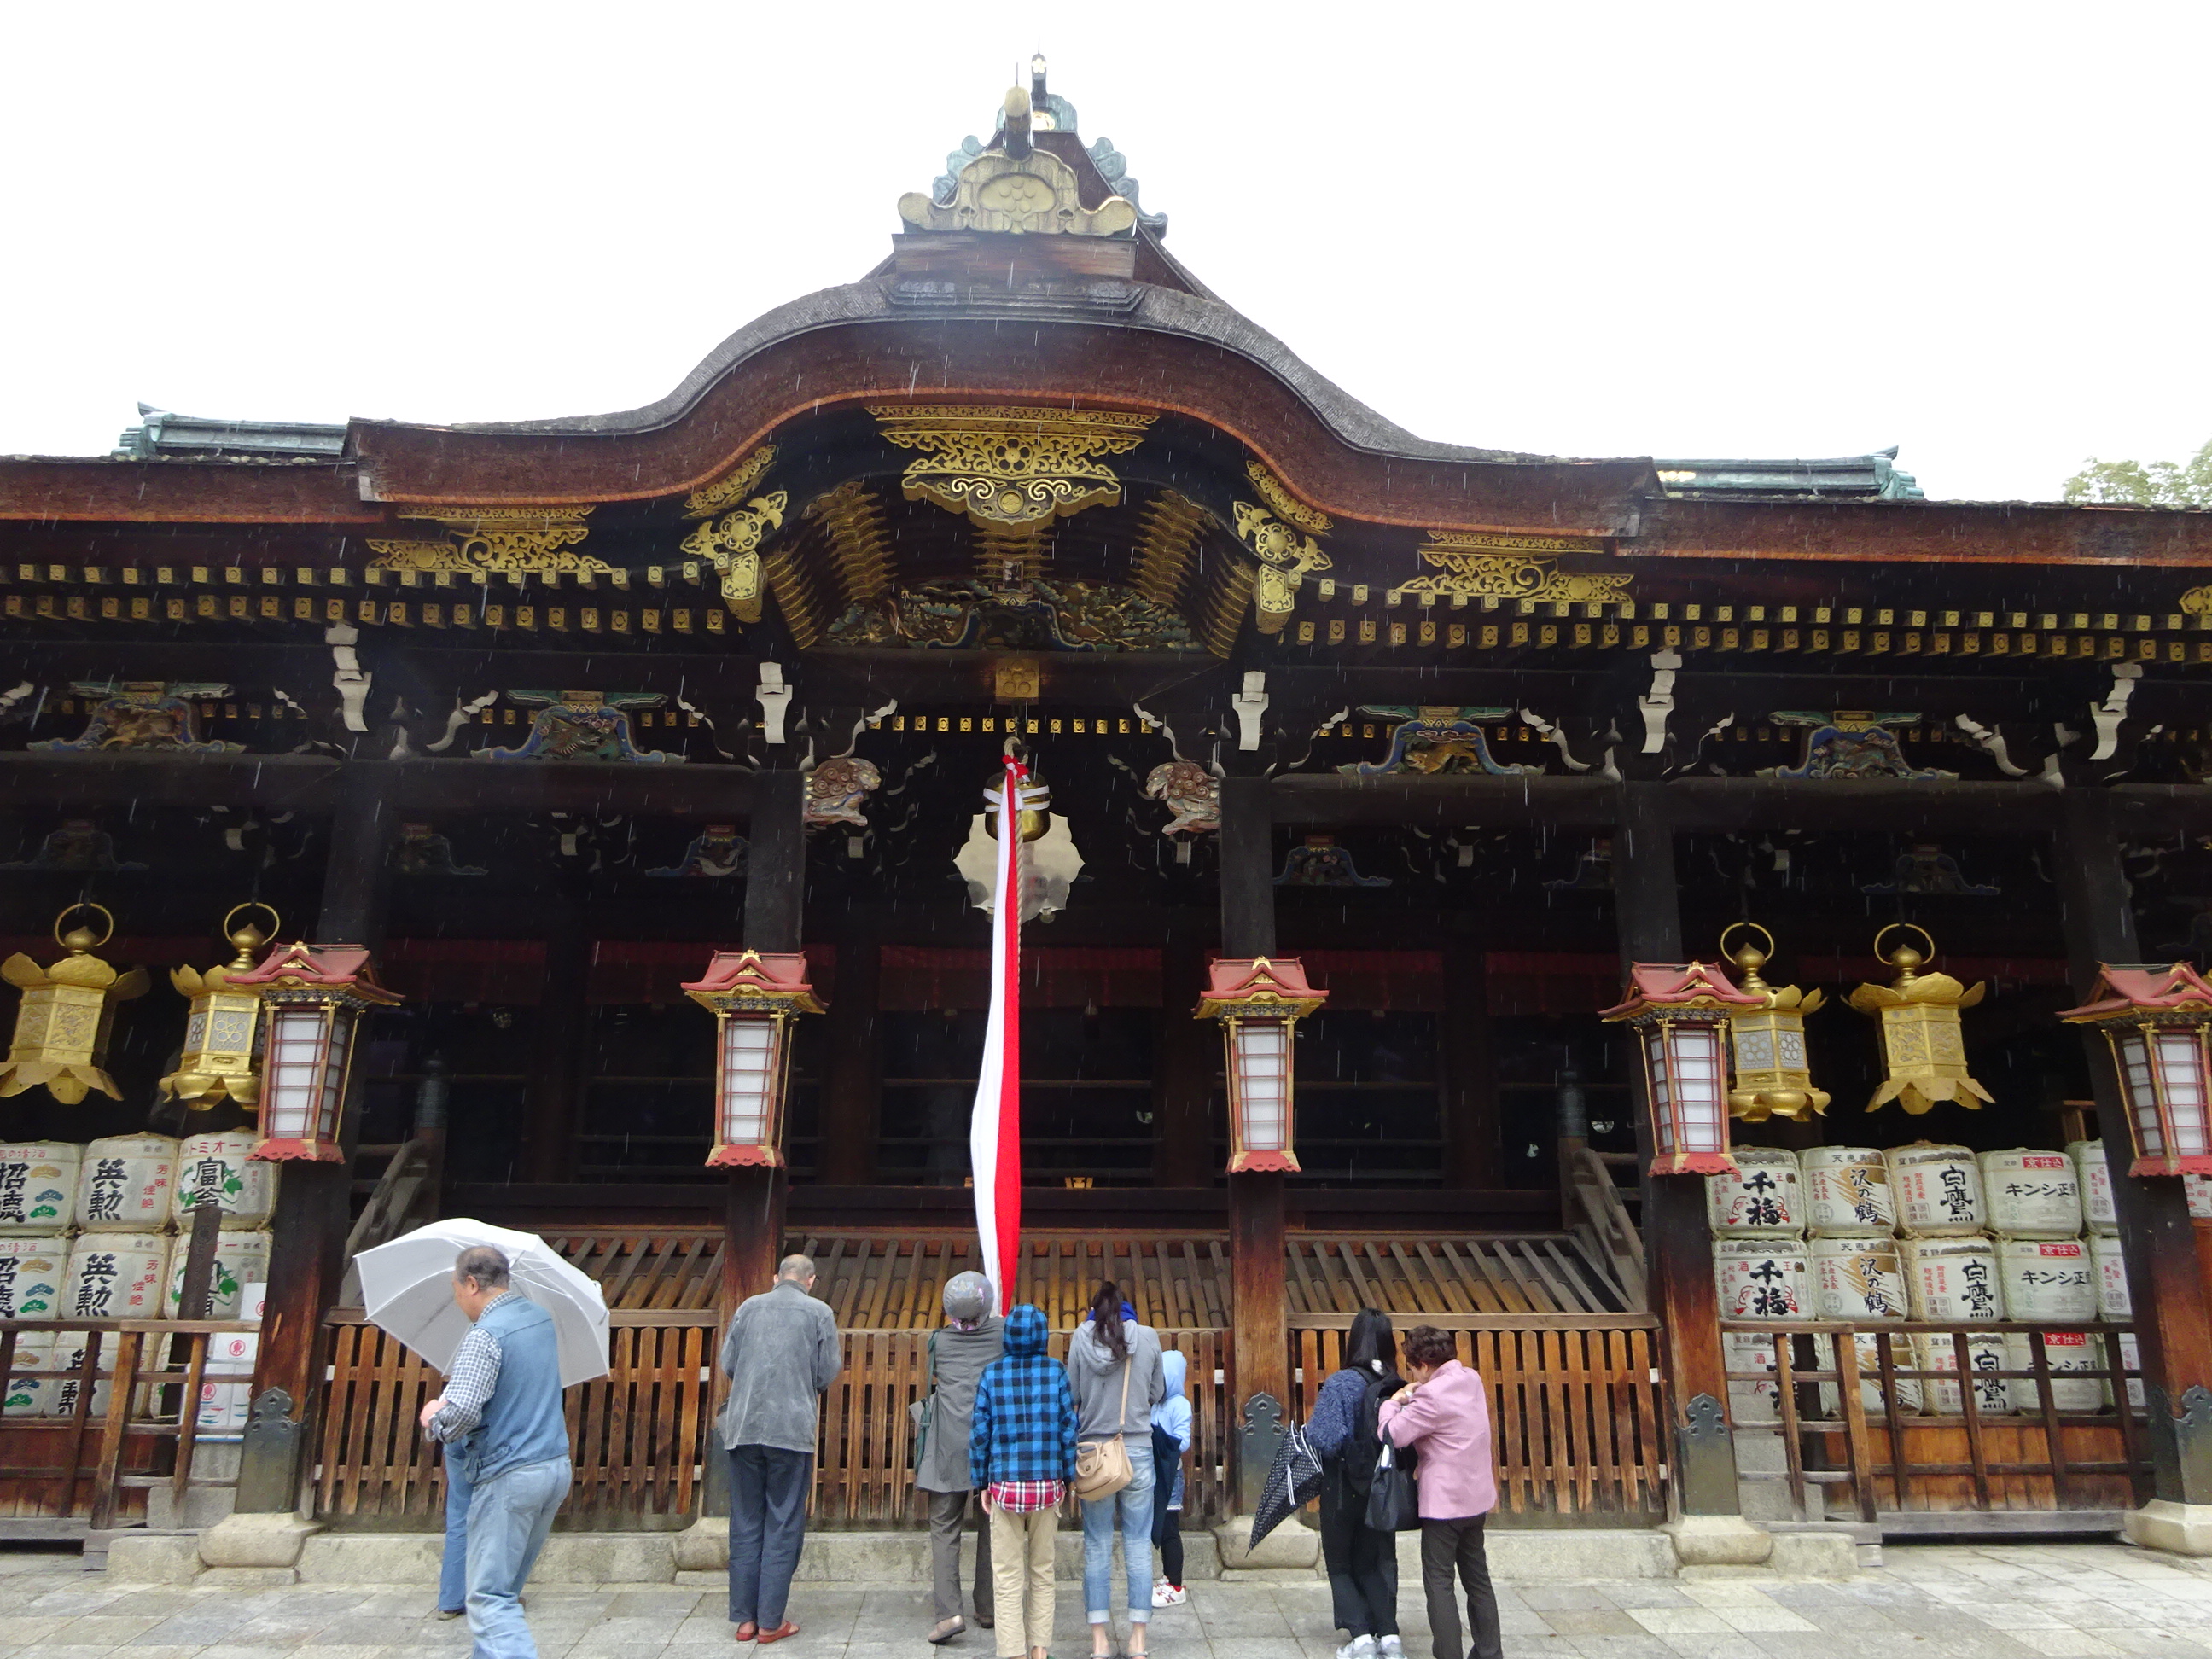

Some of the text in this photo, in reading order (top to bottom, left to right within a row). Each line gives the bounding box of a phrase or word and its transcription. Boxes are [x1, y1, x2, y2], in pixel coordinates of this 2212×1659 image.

[190, 1141, 242, 1153] トミオー
[2025, 1157, 2063, 1168] 京仕込
[1743, 1170, 1780, 1225] 千福
[1849, 1169, 1878, 1223] 沢の鶴
[1939, 1164, 1974, 1222] 白鷹
[2042, 1244, 2080, 1256] 京仕込
[1749, 1259, 1789, 1317] 千福
[1859, 1258, 1889, 1313] 沢の鶴
[1961, 1259, 1994, 1318] 白鷹
